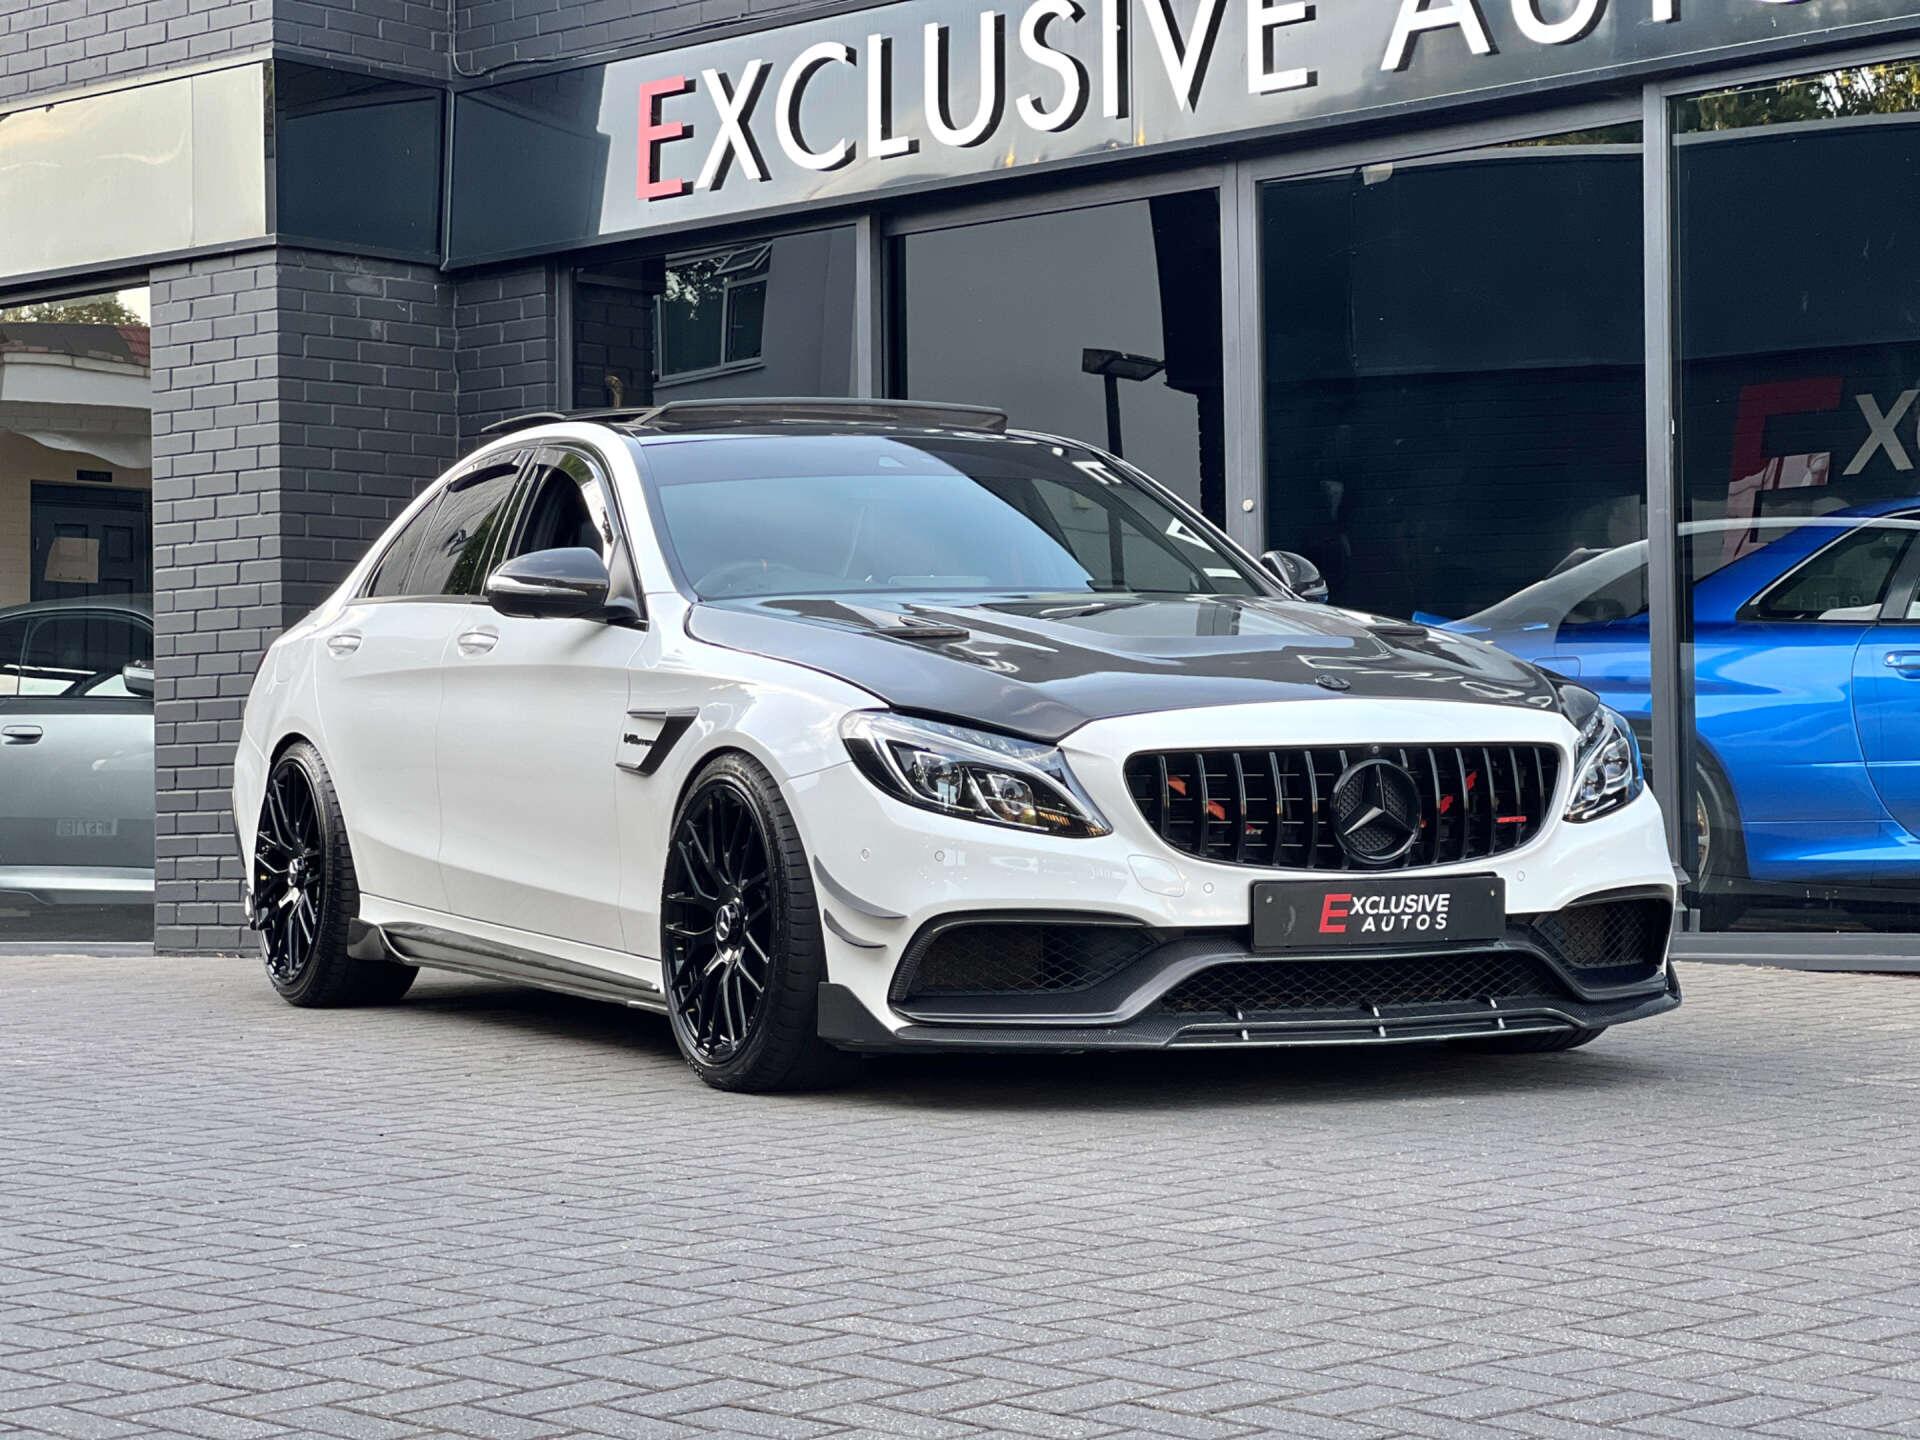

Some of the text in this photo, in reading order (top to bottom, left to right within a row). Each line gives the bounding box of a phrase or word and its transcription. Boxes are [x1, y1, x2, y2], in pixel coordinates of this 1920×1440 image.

[635, 0, 1317, 201] EXCLUSIVE
[1722, 378, 1920, 561] EX
[1319, 893, 1450, 933] EXCLUSIVE
[1362, 914, 1448, 932] AUTOS
